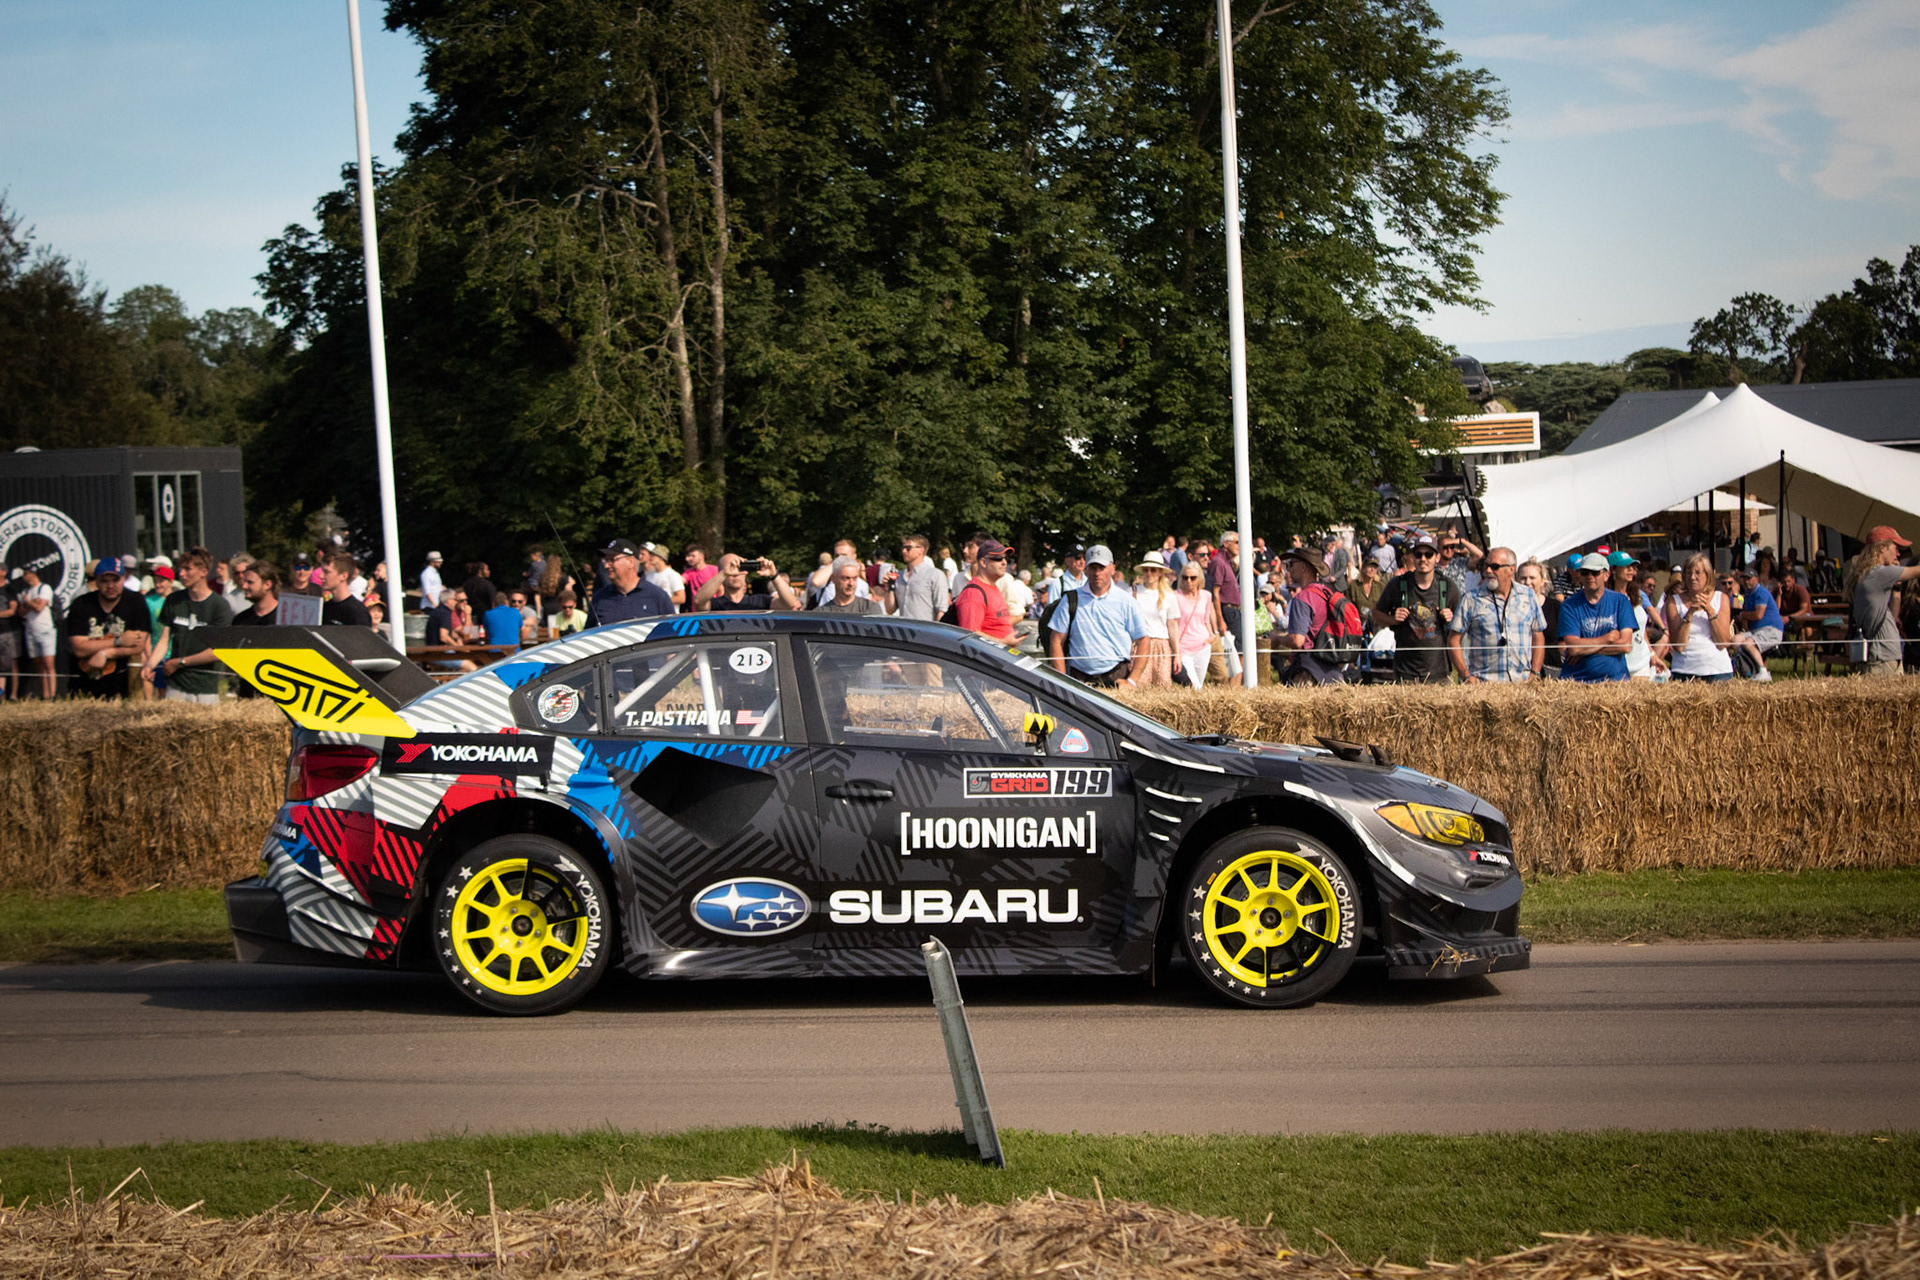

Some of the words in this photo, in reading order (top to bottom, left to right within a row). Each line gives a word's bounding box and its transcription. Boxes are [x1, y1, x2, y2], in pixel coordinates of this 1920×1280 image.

[0, 520, 28, 550] ERAL
[31, 517, 71, 544] STORE
[430, 745, 539, 763] YOKOHAMA
[1053, 769, 1111, 795] 199
[829, 888, 1079, 925] SUBARU
[1318, 857, 1356, 949] YOKOHAMA
[576, 874, 602, 969] YOKOHAMA
